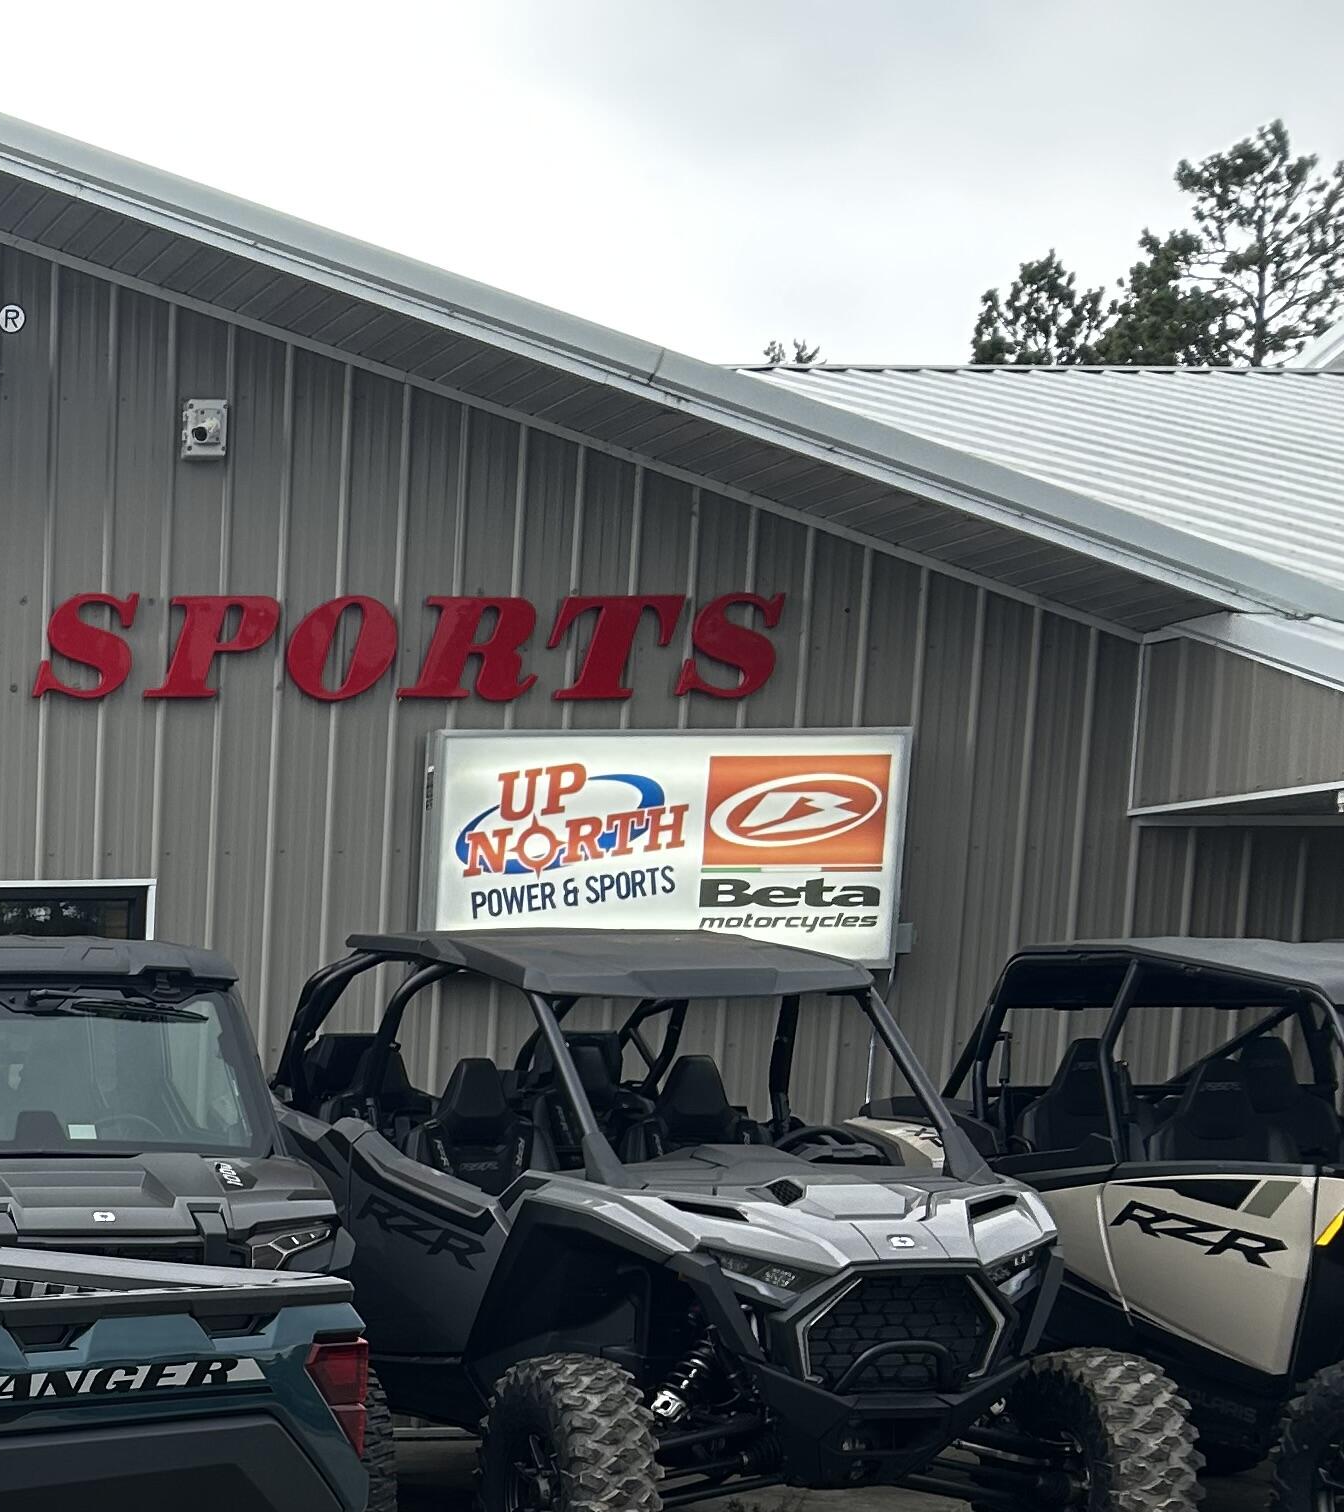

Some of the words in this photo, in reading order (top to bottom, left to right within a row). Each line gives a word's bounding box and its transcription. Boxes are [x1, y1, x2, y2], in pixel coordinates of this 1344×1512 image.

[32, 590, 786, 703] SPORTS
[498, 762, 587, 822] UP
[462, 803, 690, 879] NORTH
[470, 880, 557, 919] POWER
[563, 883, 580, 906] &
[585, 865, 676, 902] SPORTS
[699, 877, 881, 908] Beta
[699, 912, 879, 933] motorcycles
[356, 1193, 486, 1271] RZR
[1109, 1200, 1288, 1269] RZR
